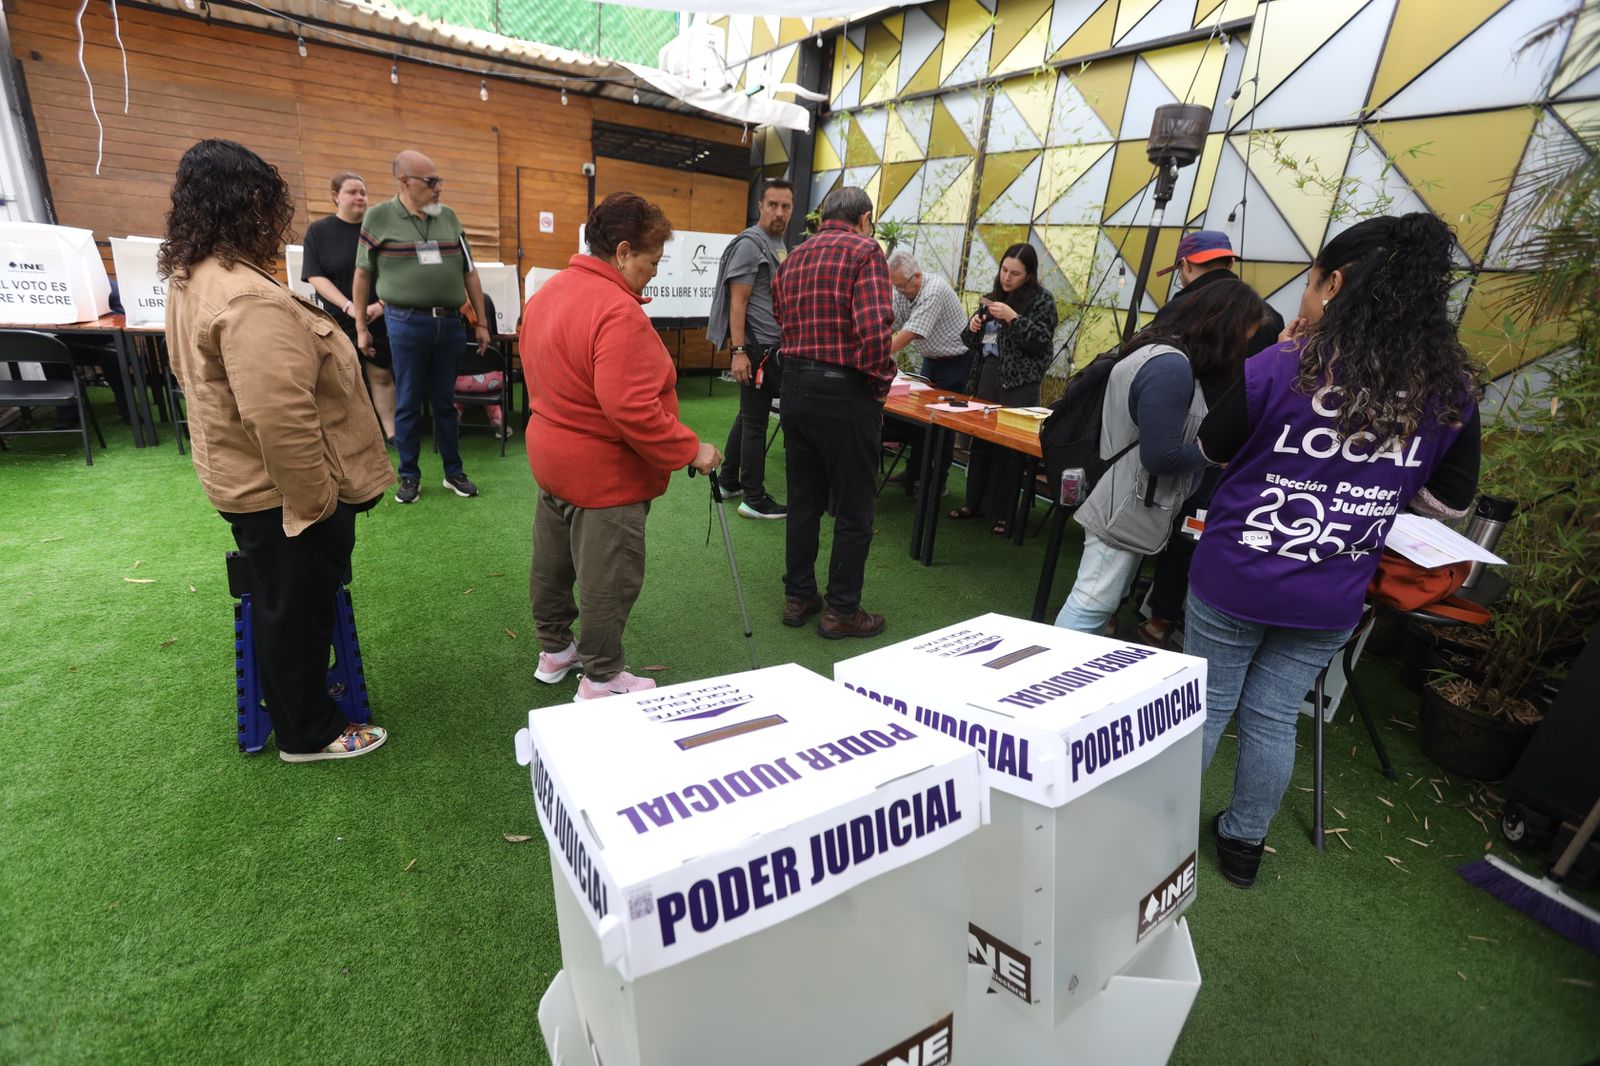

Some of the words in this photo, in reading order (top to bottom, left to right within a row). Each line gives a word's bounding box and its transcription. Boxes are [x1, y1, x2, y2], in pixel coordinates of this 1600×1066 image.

[11, 280, 47, 291] VOTO
[51, 282, 67, 292] ES
[19, 263, 45, 271] INE
[17, 294, 25, 303] Y
[138, 298, 166, 307] LIBR
[153, 285, 166, 295] EL
[644, 286, 658, 297] OTO
[661, 286, 670, 297] ES
[672, 286, 691, 298] LIBRE
[693, 287, 698, 297] Y
[1273, 424, 1422, 467] LOCAL
[1266, 473, 1328, 492] Elección
[1335, 481, 1397, 501] Poder
[1329, 498, 1398, 517] Judicial
[1245, 487, 1351, 563] 2025
[1082, 646, 1157, 672] PODER
[998, 666, 1105, 709] JUDICIAL
[798, 723, 918, 772] PODER
[1071, 715, 1135, 784] PODER
[1137, 677, 1201, 748] JUDICIAL
[617, 756, 802, 834] JUDICIAL
[532, 738, 554, 826] ODER
[554, 795, 608, 920] JUDICIAL
[656, 846, 801, 948] PODER
[810, 778, 962, 887] JUDICIAL
[1161, 861, 1195, 912] INE
[968, 931, 1027, 990] NE
[886, 1025, 949, 1066] NE
